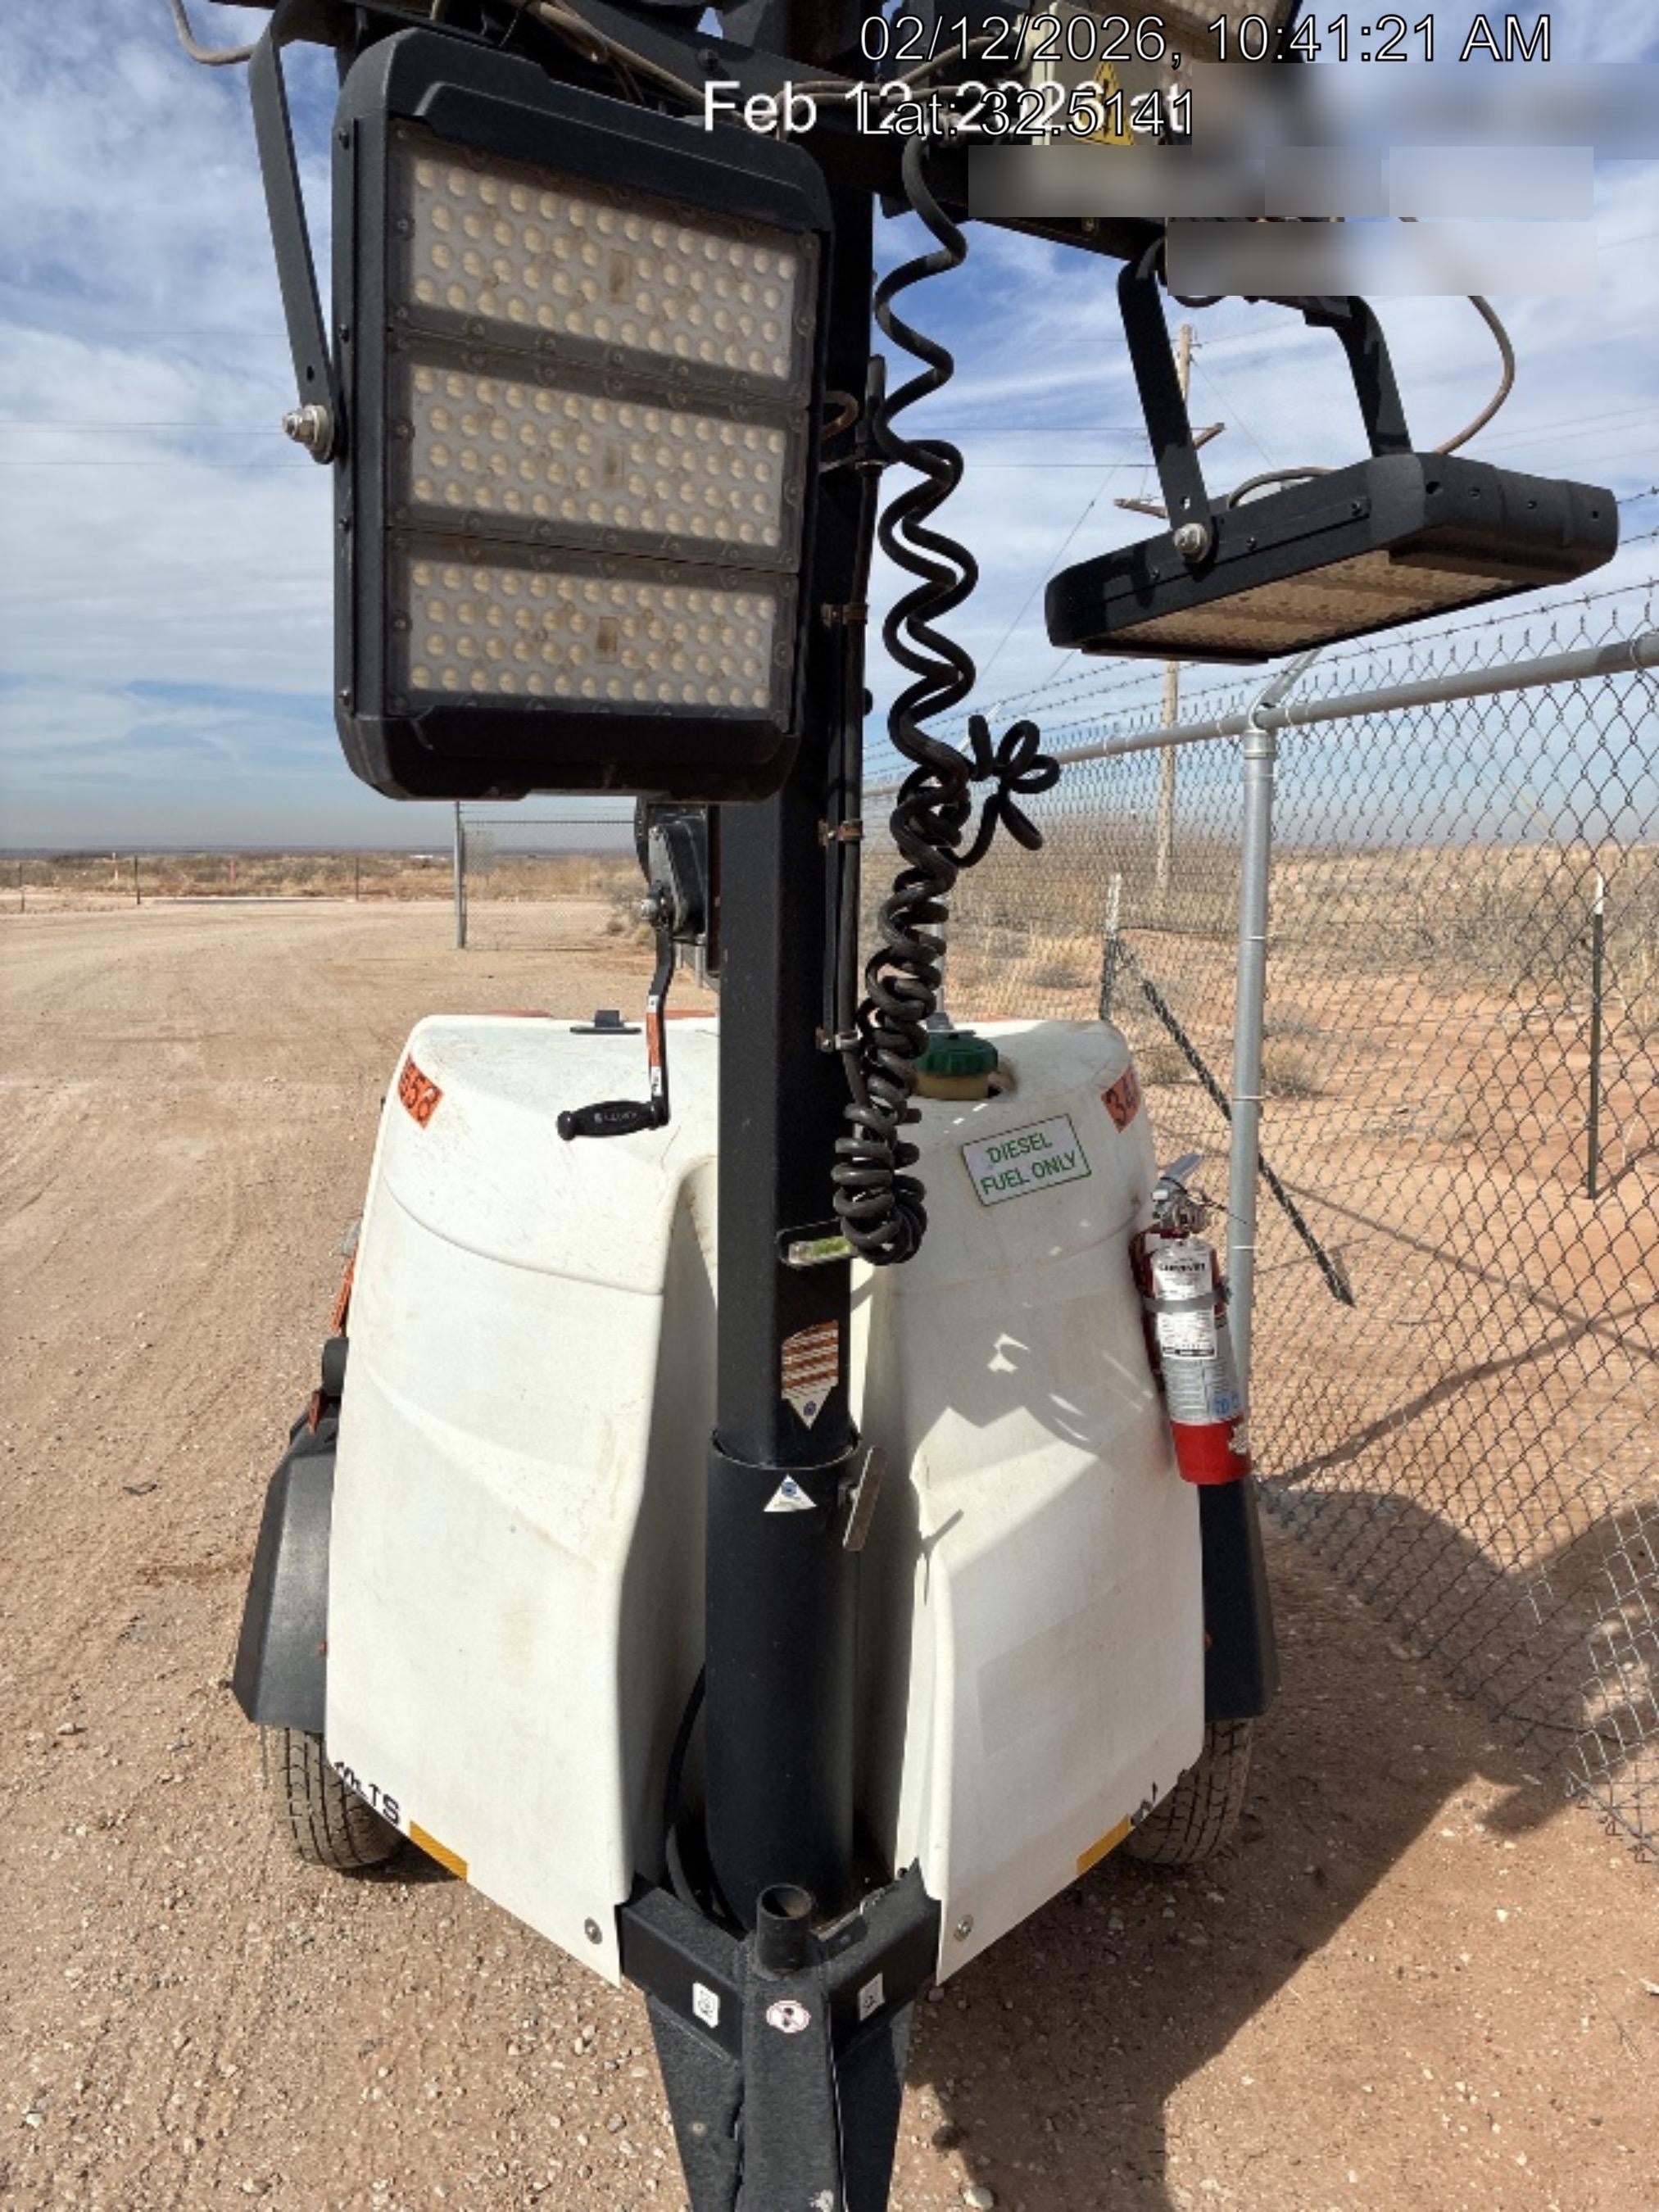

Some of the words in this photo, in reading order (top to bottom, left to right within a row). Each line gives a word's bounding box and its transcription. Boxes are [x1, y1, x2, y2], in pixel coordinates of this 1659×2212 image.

[986, 1132, 1053, 1163] DIESEL
[981, 1167, 1031, 1195] FUEL
[1031, 1150, 1075, 1180] ONLY
